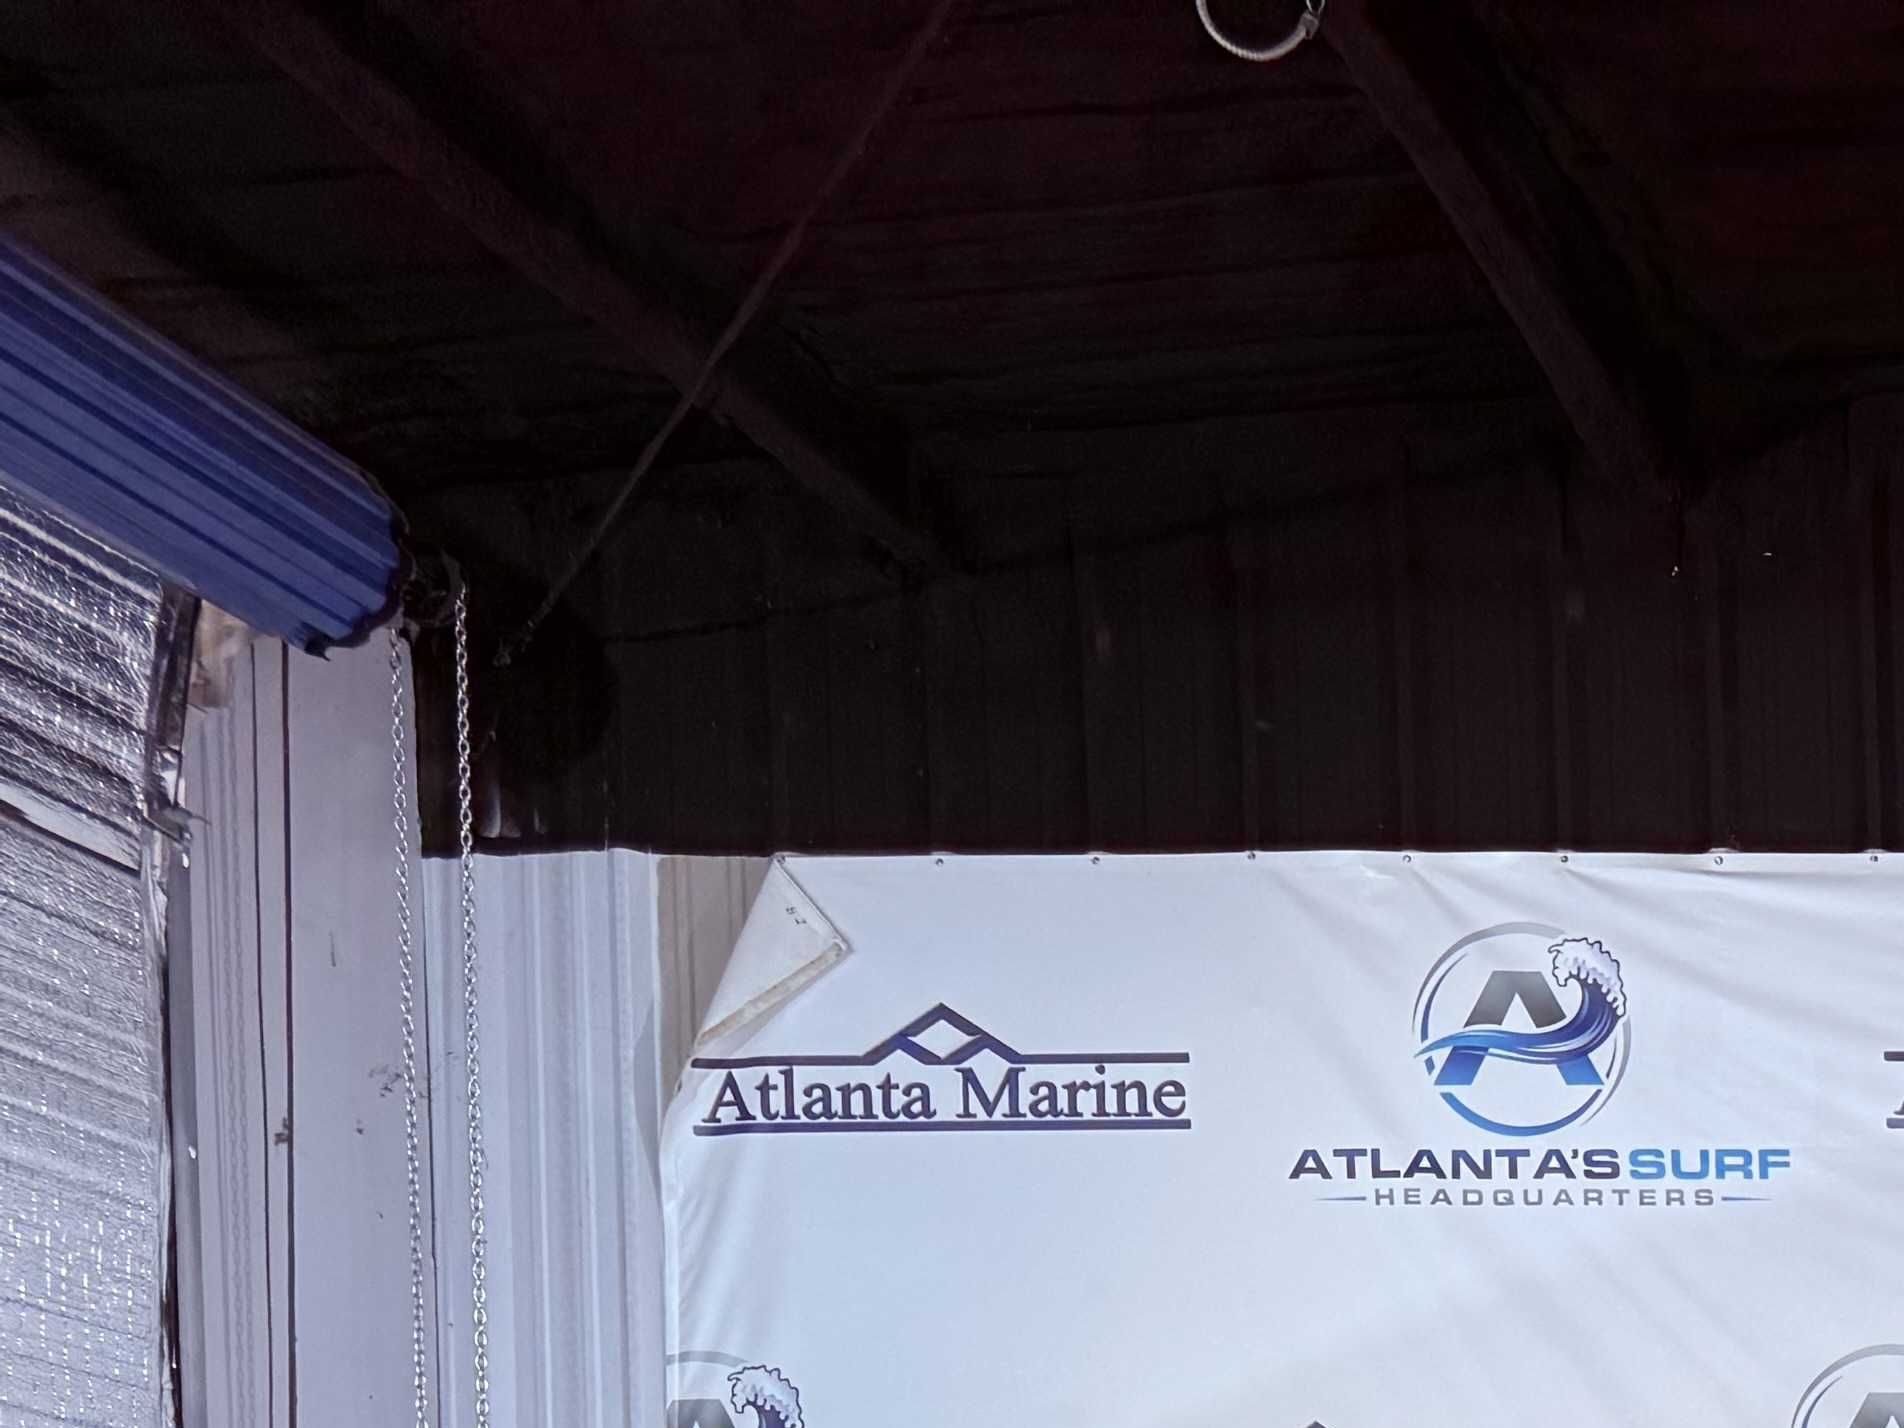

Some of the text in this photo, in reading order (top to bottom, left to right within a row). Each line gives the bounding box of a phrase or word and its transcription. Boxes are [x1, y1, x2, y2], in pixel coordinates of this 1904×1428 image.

[702, 1064, 1186, 1121] Atlanta Marine
[1375, 1188, 1713, 1206] HEADQUARTERS
